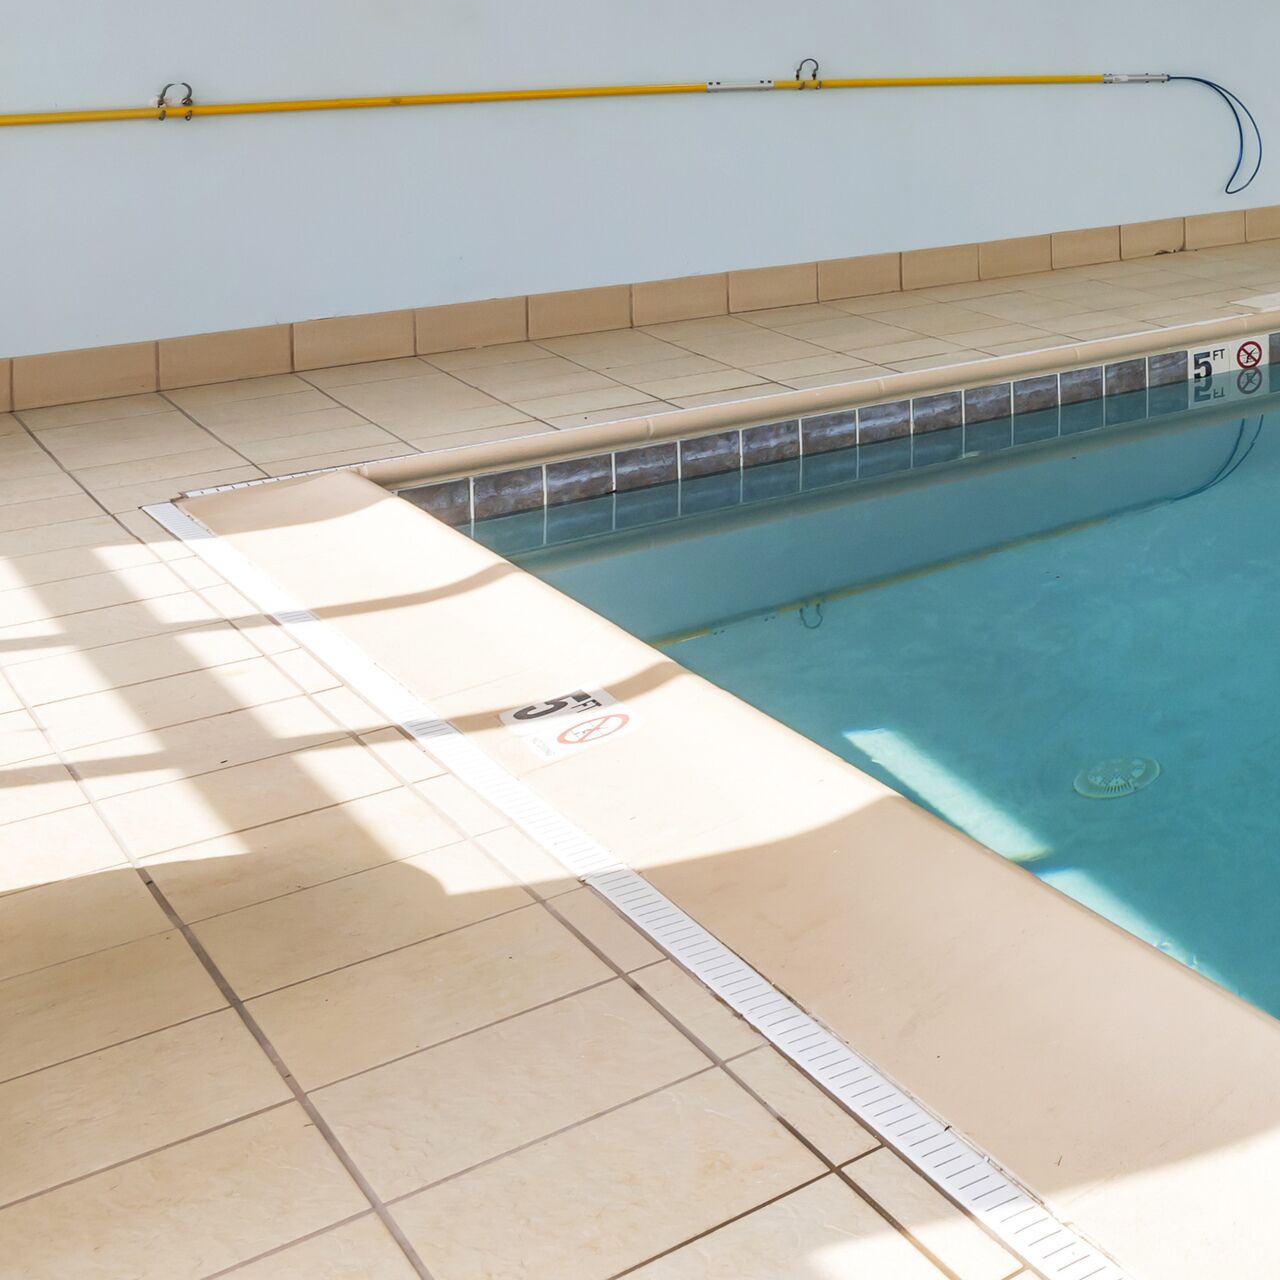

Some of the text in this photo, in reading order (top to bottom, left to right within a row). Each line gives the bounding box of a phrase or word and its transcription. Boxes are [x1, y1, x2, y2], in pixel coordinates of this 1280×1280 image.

[1193, 348, 1225, 379] 5 FT
[513, 689, 602, 720] 5 FT
